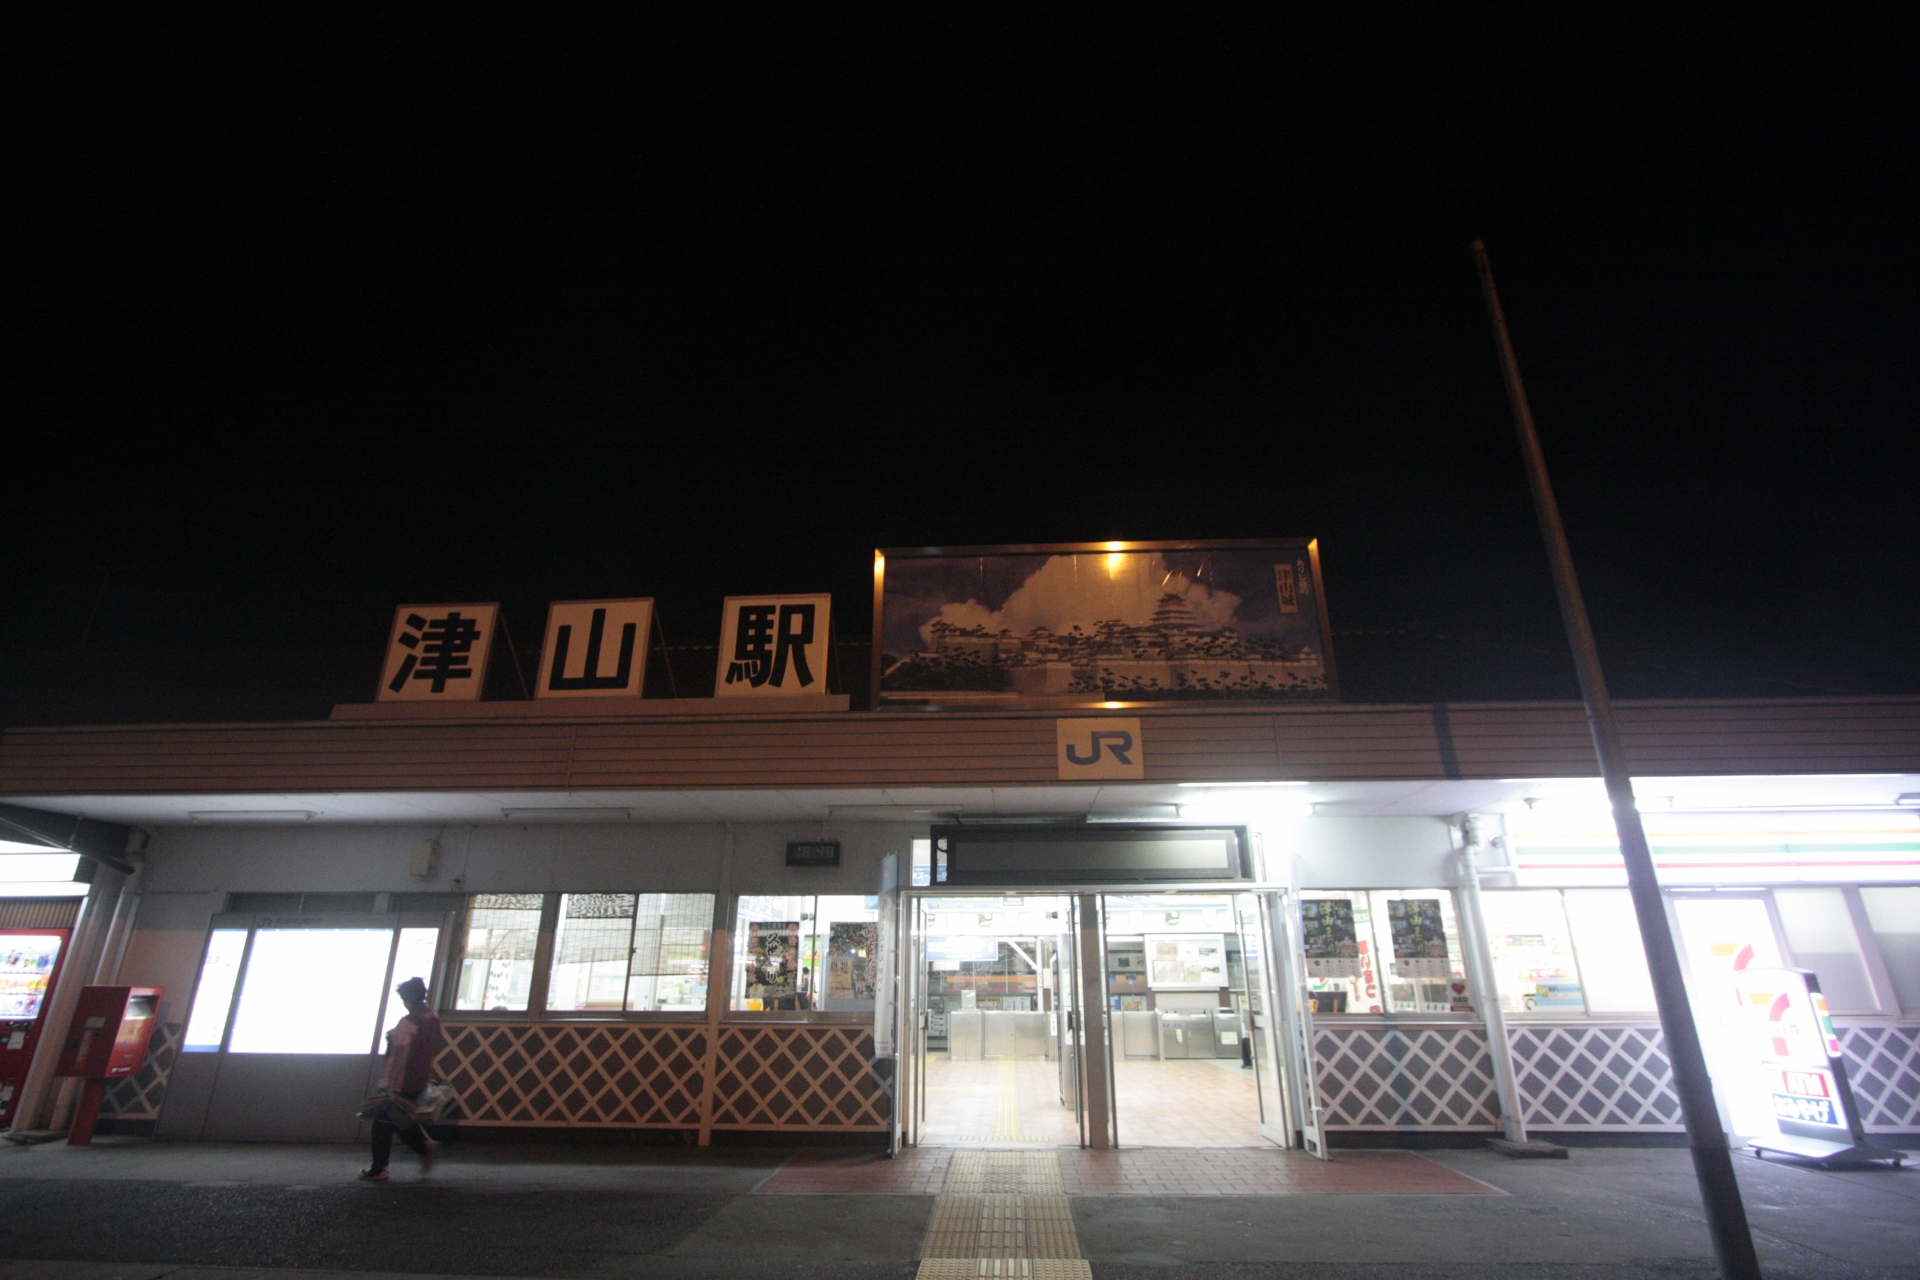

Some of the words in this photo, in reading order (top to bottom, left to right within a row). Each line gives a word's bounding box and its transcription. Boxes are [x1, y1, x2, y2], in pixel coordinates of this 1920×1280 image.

[388, 603, 816, 694] 津山駅
[1066, 730, 1133, 766] JR
[1786, 1072, 1826, 1096] ATM
[1773, 1095, 1830, 1123] おみやげ
